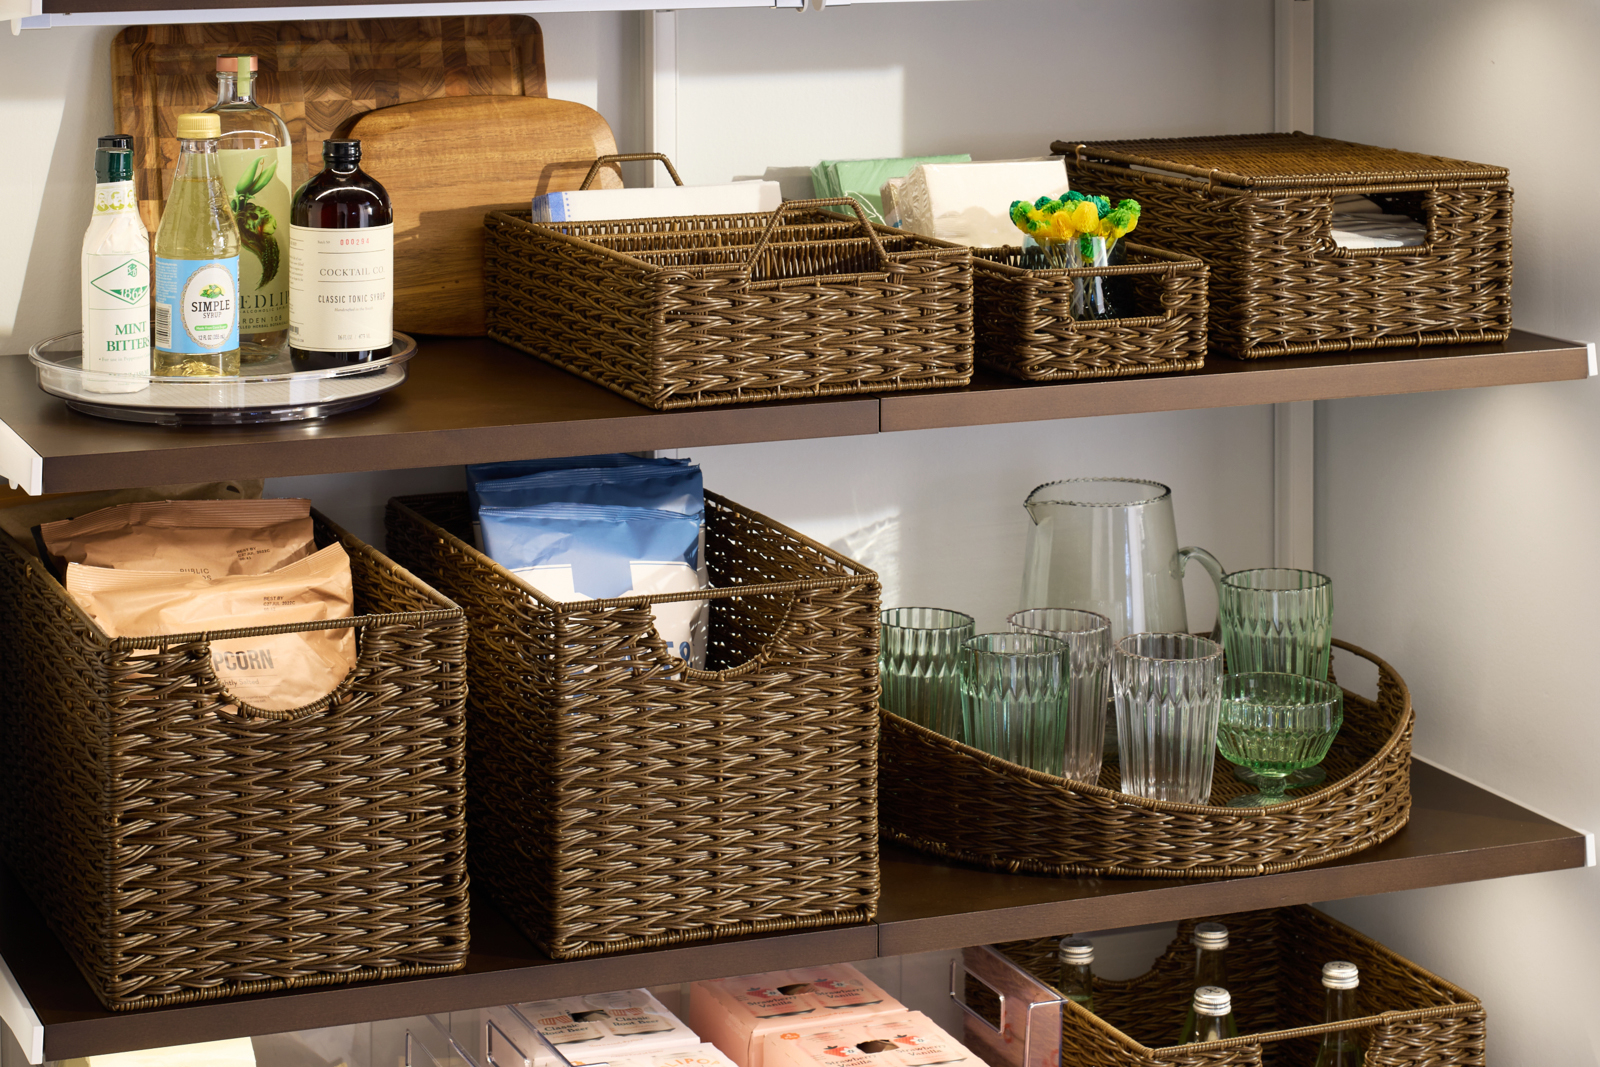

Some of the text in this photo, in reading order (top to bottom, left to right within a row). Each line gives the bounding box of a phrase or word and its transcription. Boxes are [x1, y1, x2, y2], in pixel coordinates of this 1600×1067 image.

[319, 266, 385, 277] COCKTAIL CO.
[240, 290, 289, 308] EDLIP
[318, 292, 386, 304] CLASSIC TONIC SYRUP
[191, 300, 231, 312] SIMPLE
[115, 321, 146, 335] MINT
[212, 649, 274, 672] PCORN
[814, 988, 864, 996] Strawberry
[747, 996, 797, 1006] Strawberry
[544, 1023, 580, 1032] Classic
[895, 1044, 946, 1053] Strawberry
[660, 1058, 720, 1067] LIPOP
[824, 1055, 876, 1065] Strawberry
